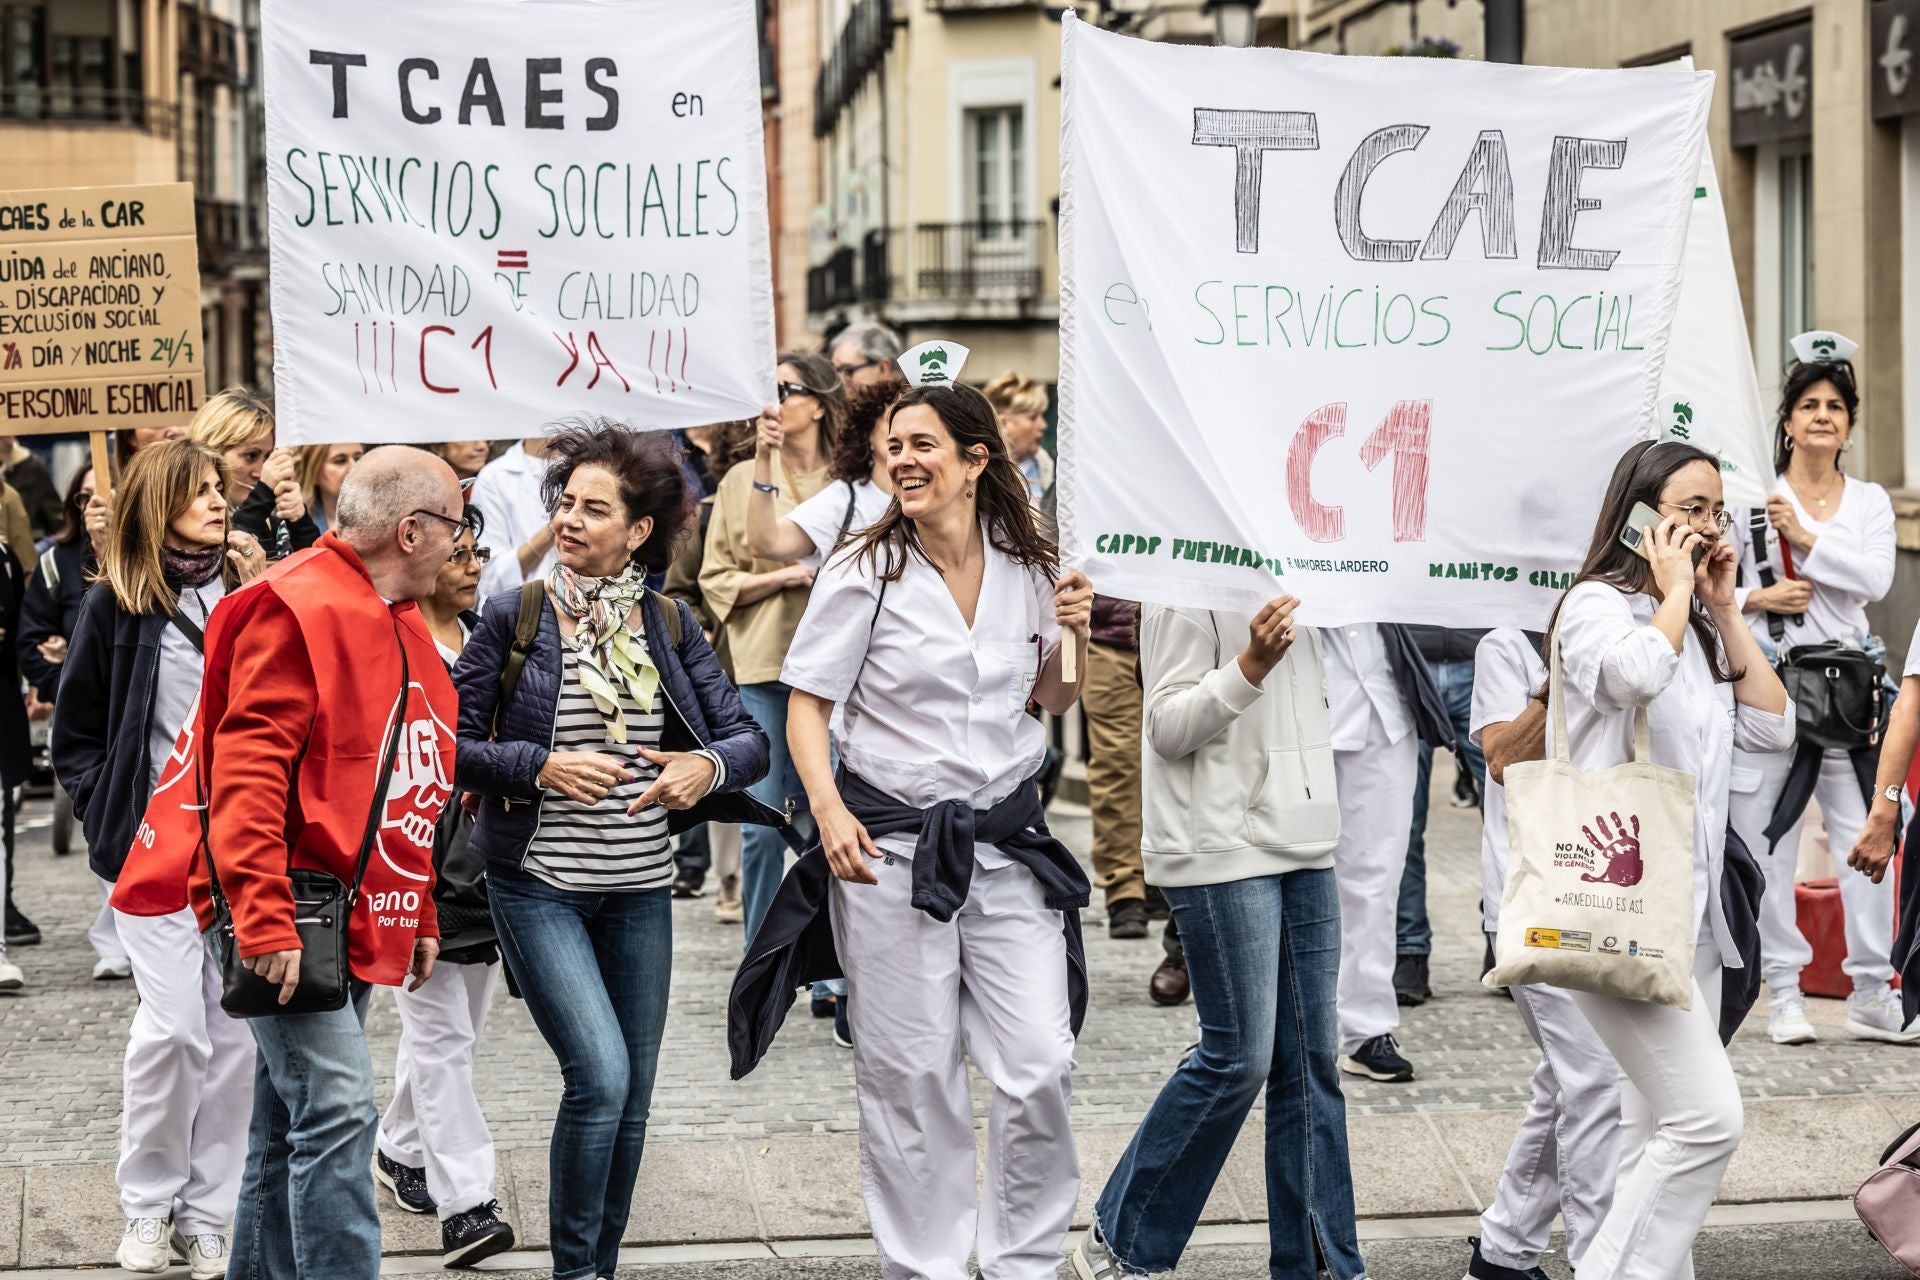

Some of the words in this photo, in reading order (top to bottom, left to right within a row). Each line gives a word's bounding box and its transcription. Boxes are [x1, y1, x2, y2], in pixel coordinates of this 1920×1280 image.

[672, 91, 704, 119] en
[286, 147, 501, 240] SERVICIOS
[534, 157, 739, 239] SOCIALES
[1192, 106, 1628, 271] TCAE
[59, 208, 76, 229] de
[82, 209, 95, 228] la
[101, 201, 145, 228] CAR
[53, 257, 77, 279] del
[16, 280, 140, 310] DISCAPACIDAD
[322, 262, 471, 317] SANIDAD
[558, 271, 699, 320] CALIDAD
[104, 305, 161, 328] SOCIAL
[1194, 280, 1451, 351] SERVICIOS
[1485, 289, 1644, 356] SOCIAL
[32, 338, 63, 368] DÍA
[86, 339, 141, 365] NOCHE
[150, 329, 194, 368] 24/7
[107, 375, 198, 414] ESENCIAL
[1285, 397, 1434, 544] C1
[1294, 558, 1332, 572] MAYORES
[1334, 560, 1389, 573] LARDERO
[1555, 853, 1595, 865] VIOLENCIA
[1556, 843, 1573, 851] NO
[1565, 860, 1595, 871] GÉNERO
[1616, 897, 1627, 912] ES
[1629, 898, 1643, 914] ASÍ
[378, 915, 397, 927] Por
[400, 915, 419, 928] tus
